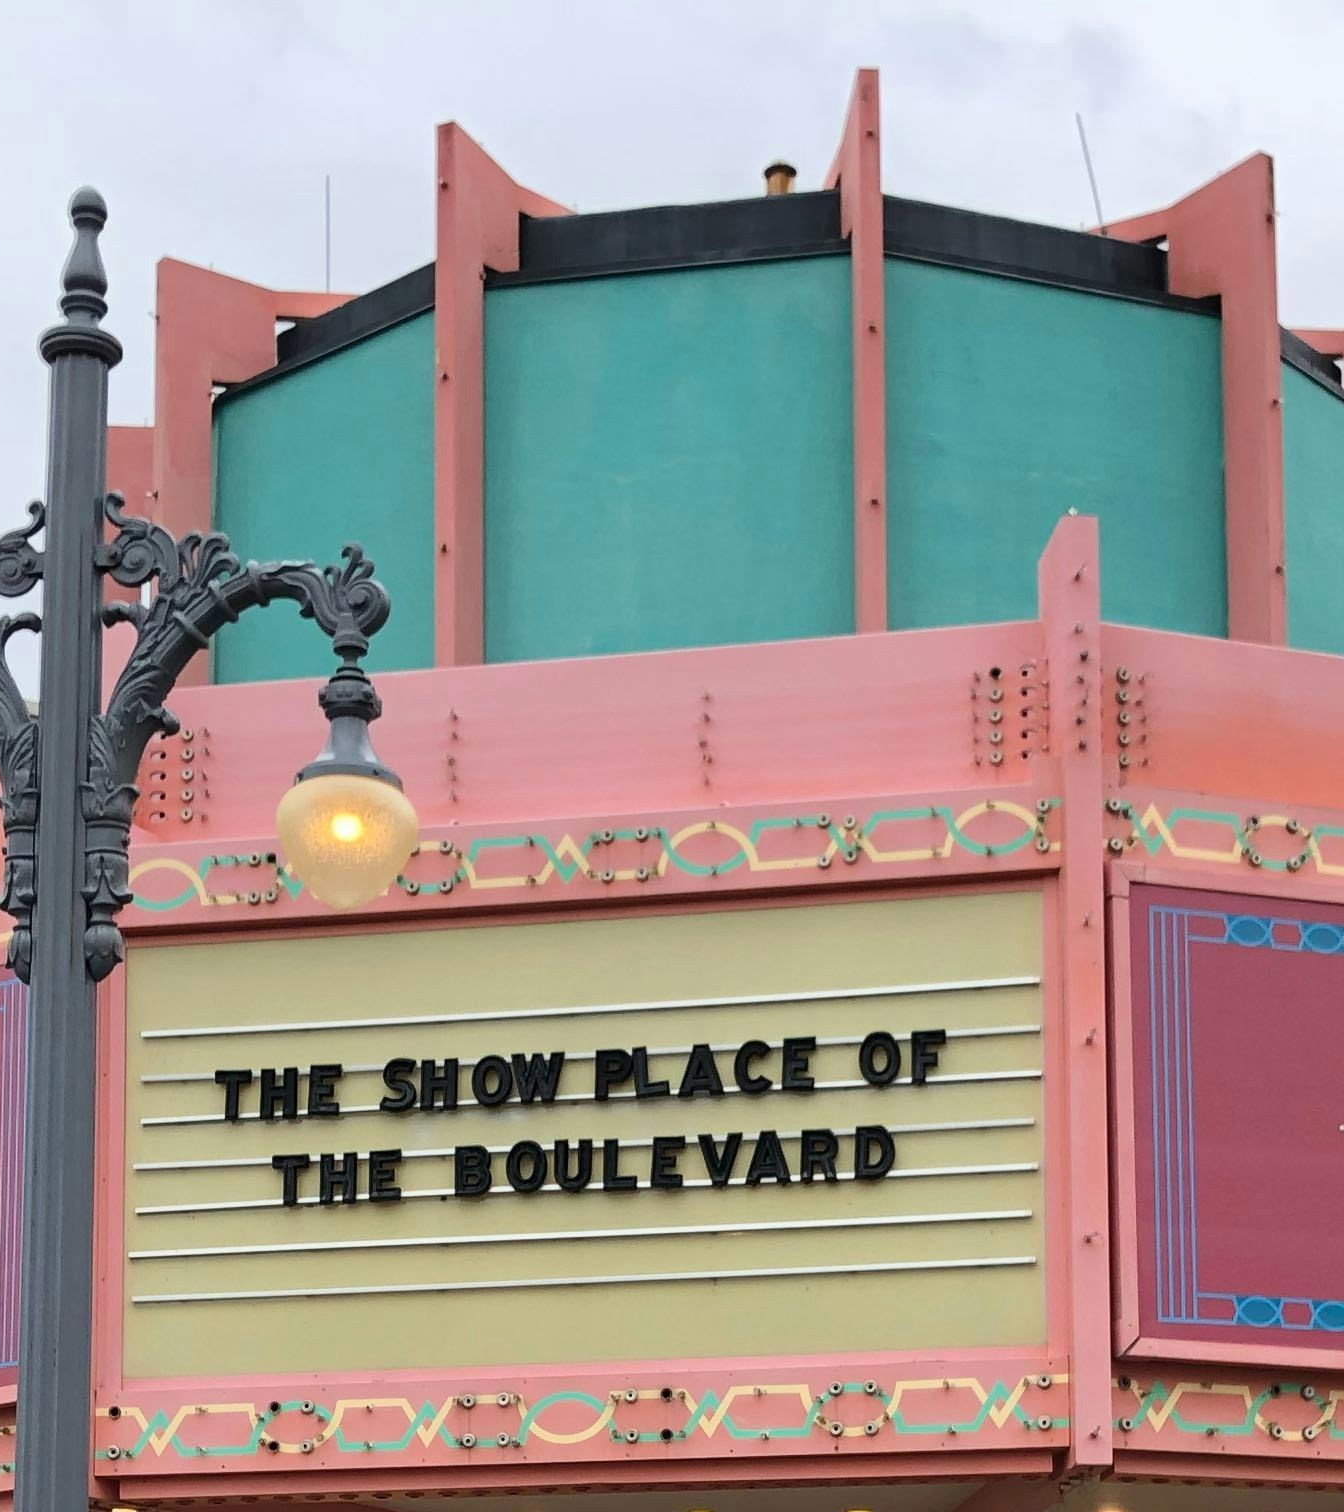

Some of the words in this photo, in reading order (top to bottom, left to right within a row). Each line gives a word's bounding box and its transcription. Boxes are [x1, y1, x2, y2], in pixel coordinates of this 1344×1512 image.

[214, 1064, 342, 1121] THE
[379, 1052, 565, 1113] SHOW
[594, 1036, 817, 1102] PLACE
[857, 1029, 947, 1088] OF
[271, 1148, 403, 1208] THE
[454, 1125, 896, 1197] BOULEVARD
